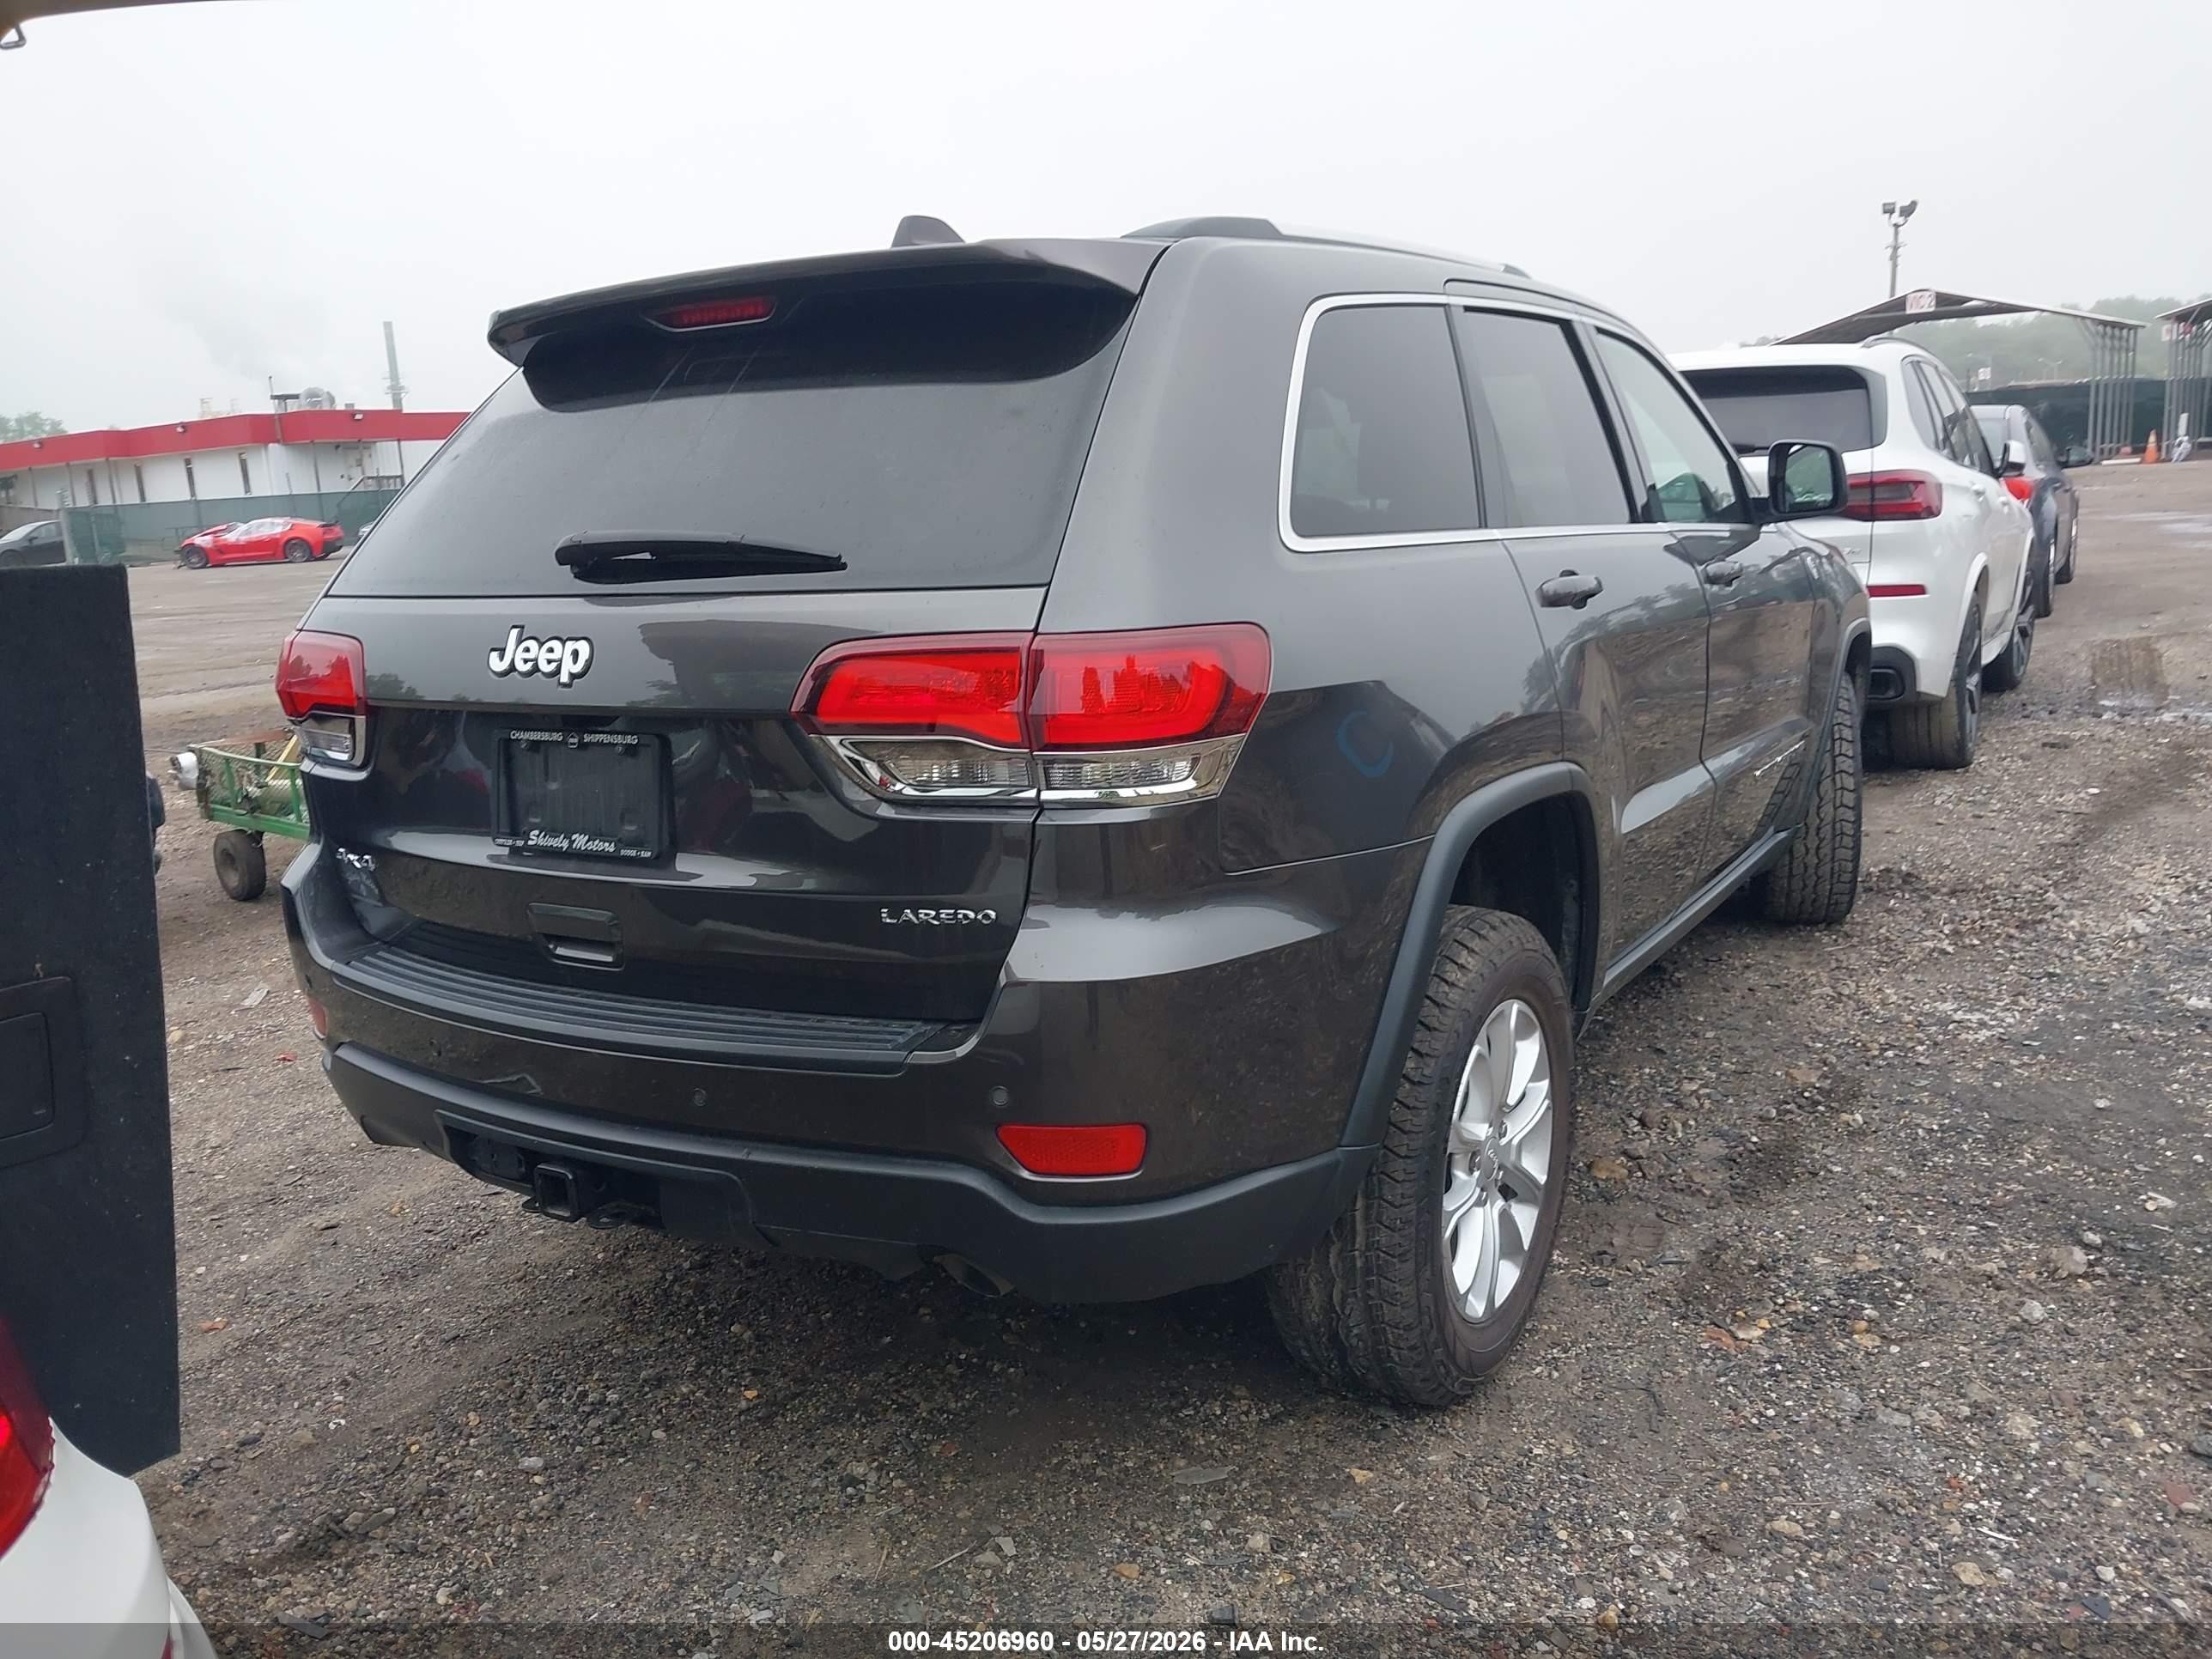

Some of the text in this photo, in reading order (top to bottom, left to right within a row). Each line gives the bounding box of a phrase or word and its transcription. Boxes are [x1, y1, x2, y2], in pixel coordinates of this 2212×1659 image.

[489, 625, 593, 688] Jeep
[527, 830, 570, 852] Shively
[571, 833, 617, 853] Motors
[880, 908, 997, 925] LAREDO
